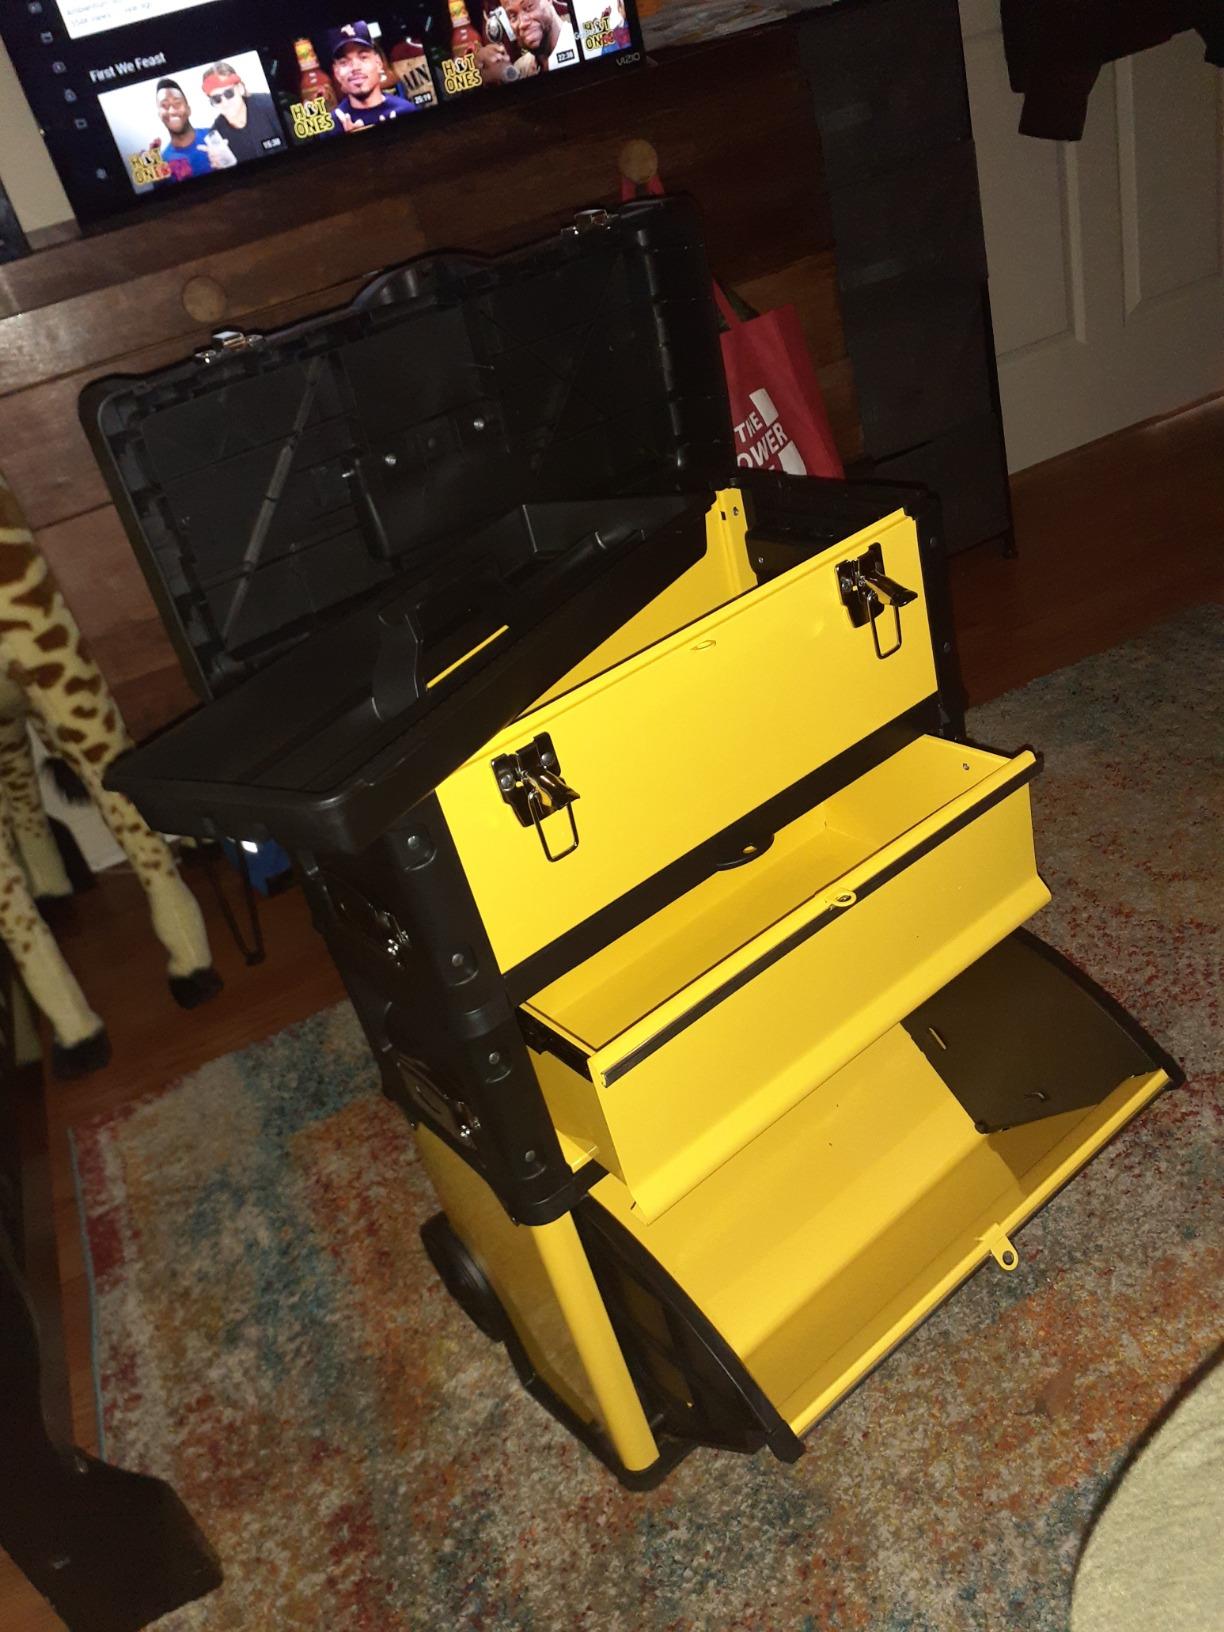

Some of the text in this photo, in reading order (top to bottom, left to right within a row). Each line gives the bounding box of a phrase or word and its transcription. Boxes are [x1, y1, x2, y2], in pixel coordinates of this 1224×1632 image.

[89, 51, 167, 83] First We Feast
[441, 53, 475, 77] HOT
[616, 52, 640, 66] VIZIO
[444, 70, 482, 94] ONES
[290, 97, 327, 122] HOT
[294, 113, 335, 138] ONES
[733, 411, 763, 443] THE
